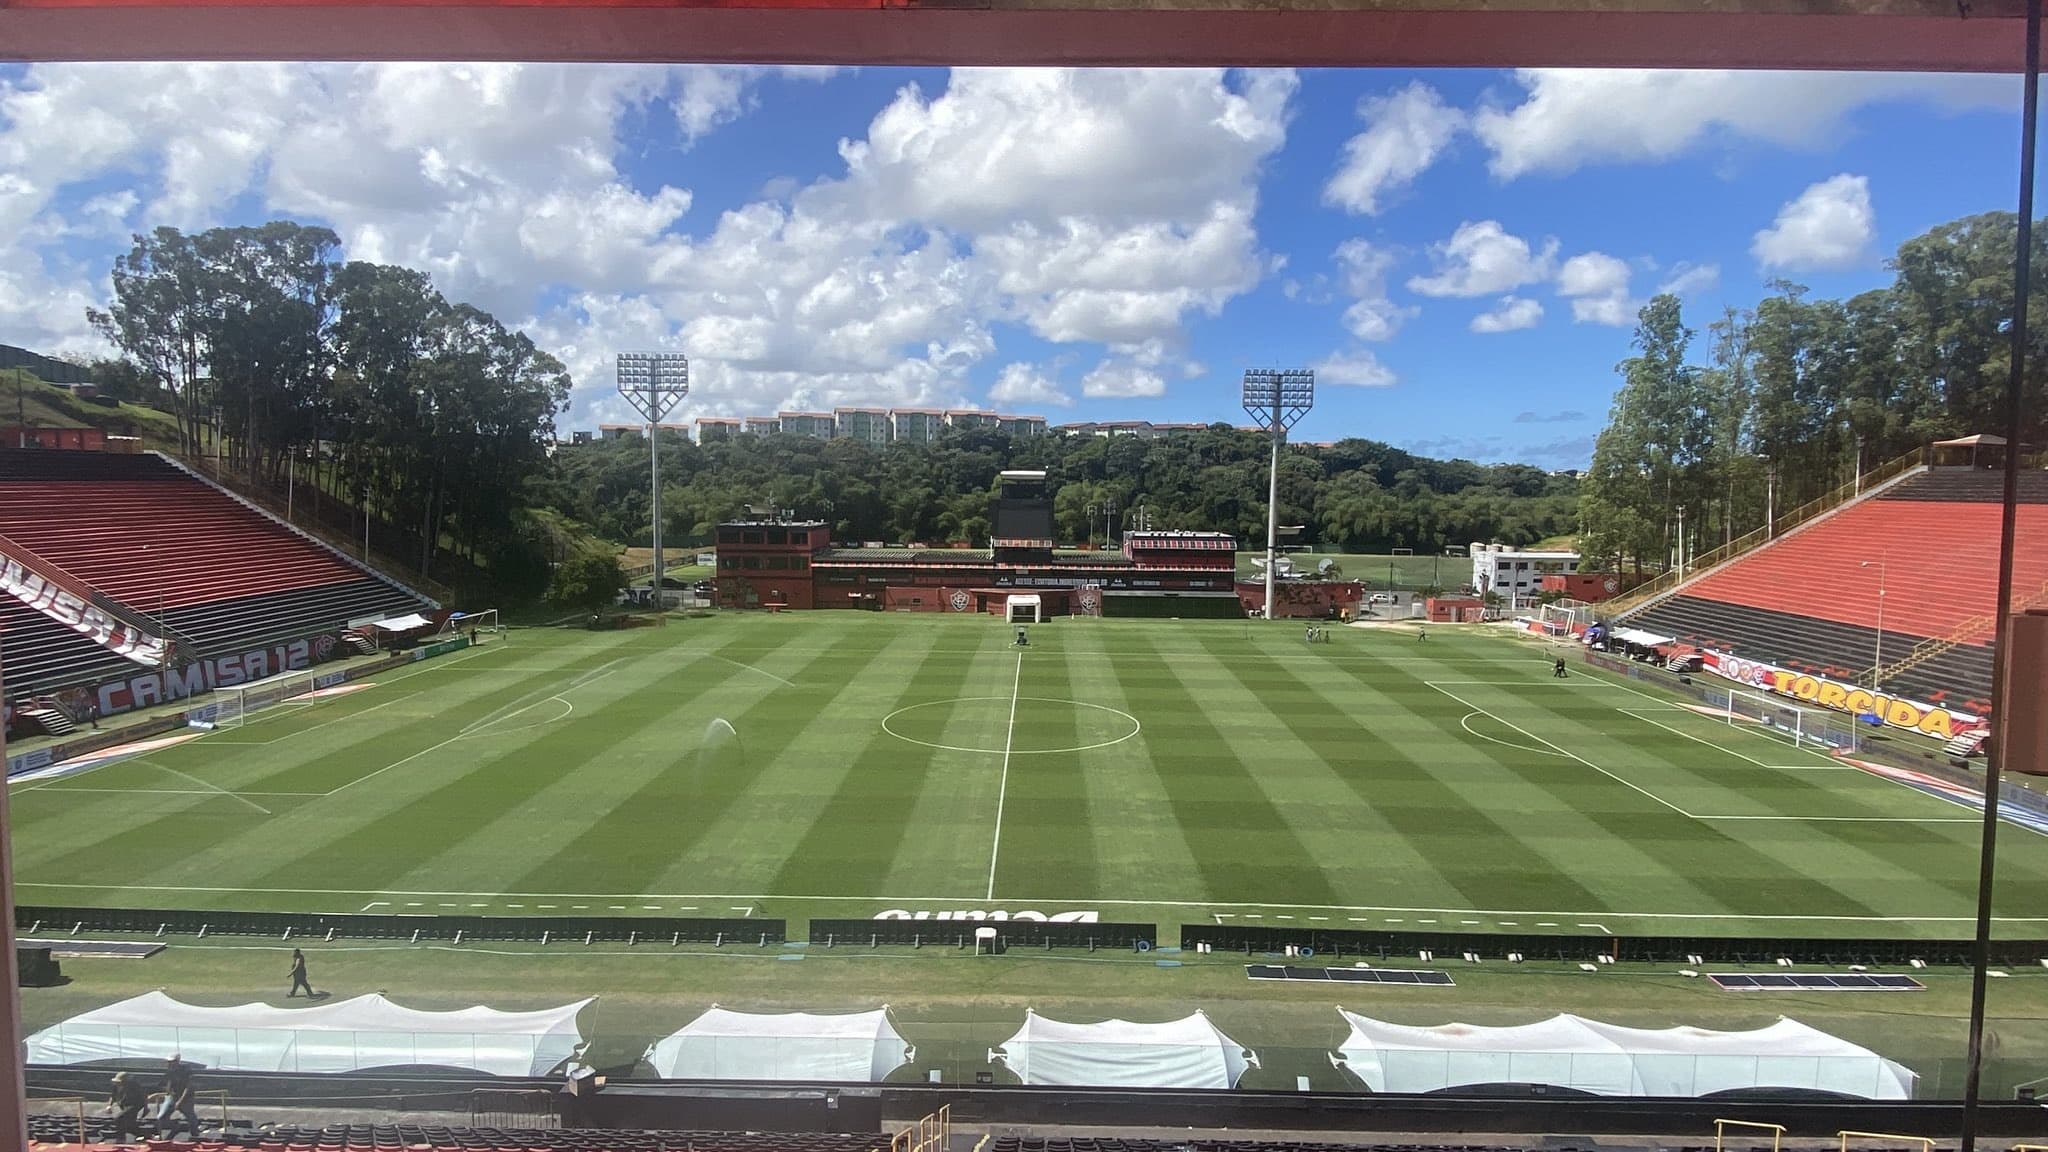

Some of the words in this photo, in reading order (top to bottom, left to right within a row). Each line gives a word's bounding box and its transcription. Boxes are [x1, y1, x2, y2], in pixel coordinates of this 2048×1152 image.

[98, 649, 269, 716] CAMISA
[275, 639, 309, 672] 12
[1773, 670, 1953, 739] TORCIDA
